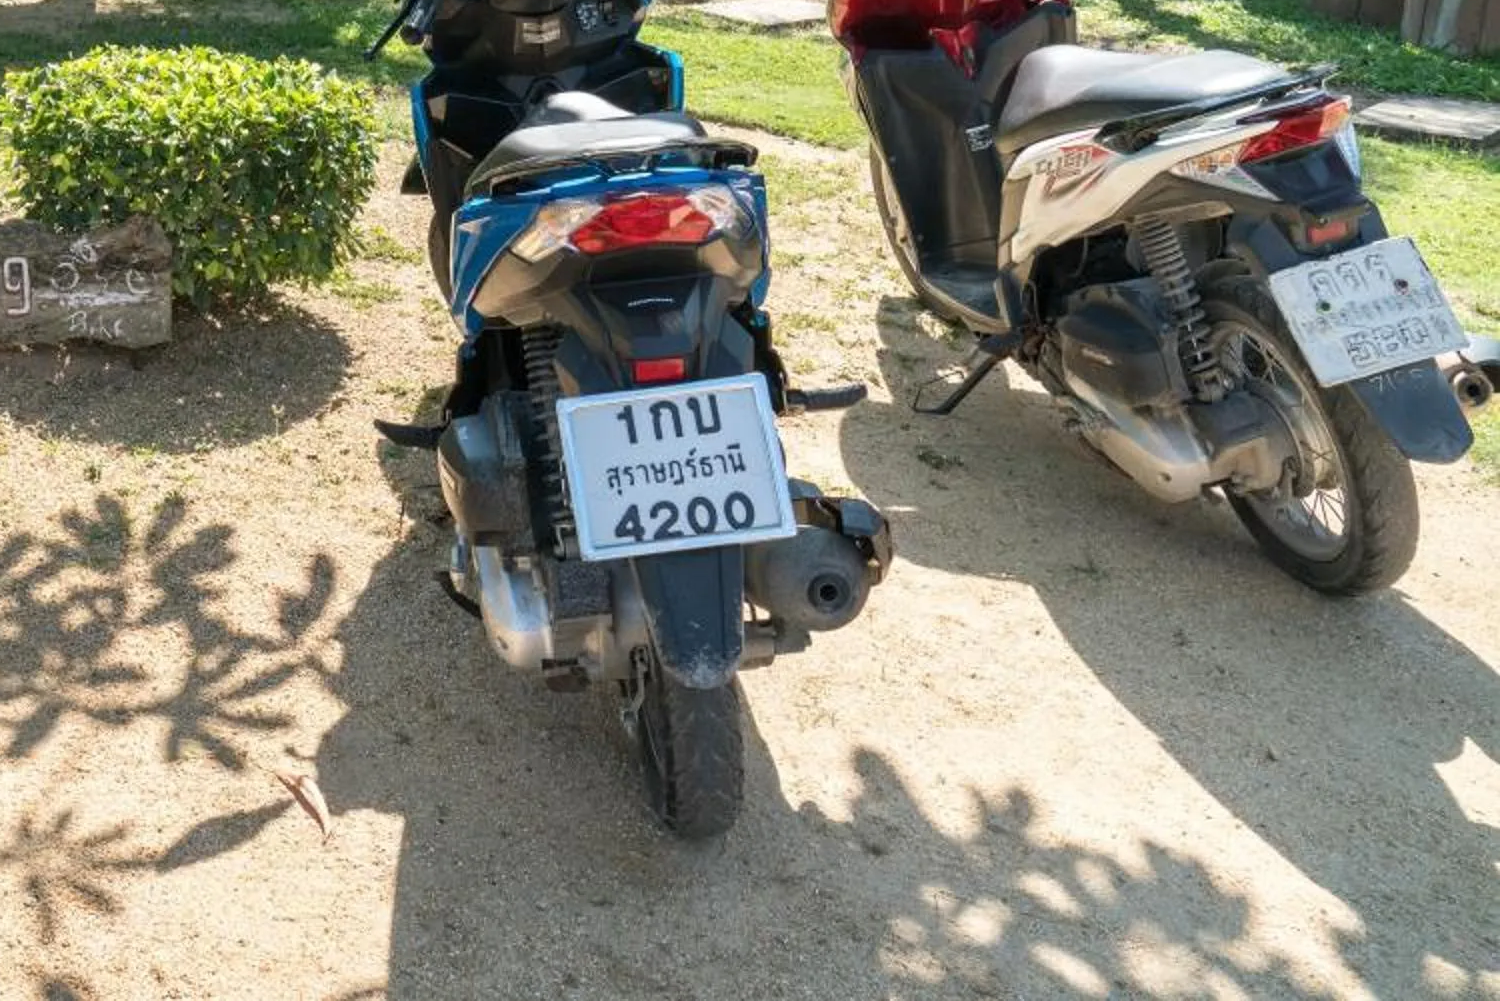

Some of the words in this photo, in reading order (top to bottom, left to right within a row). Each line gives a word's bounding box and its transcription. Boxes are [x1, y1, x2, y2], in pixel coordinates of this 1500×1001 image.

[605, 442, 747, 496] สุราษฎร์ธานี
[614, 490, 756, 542] 4200
